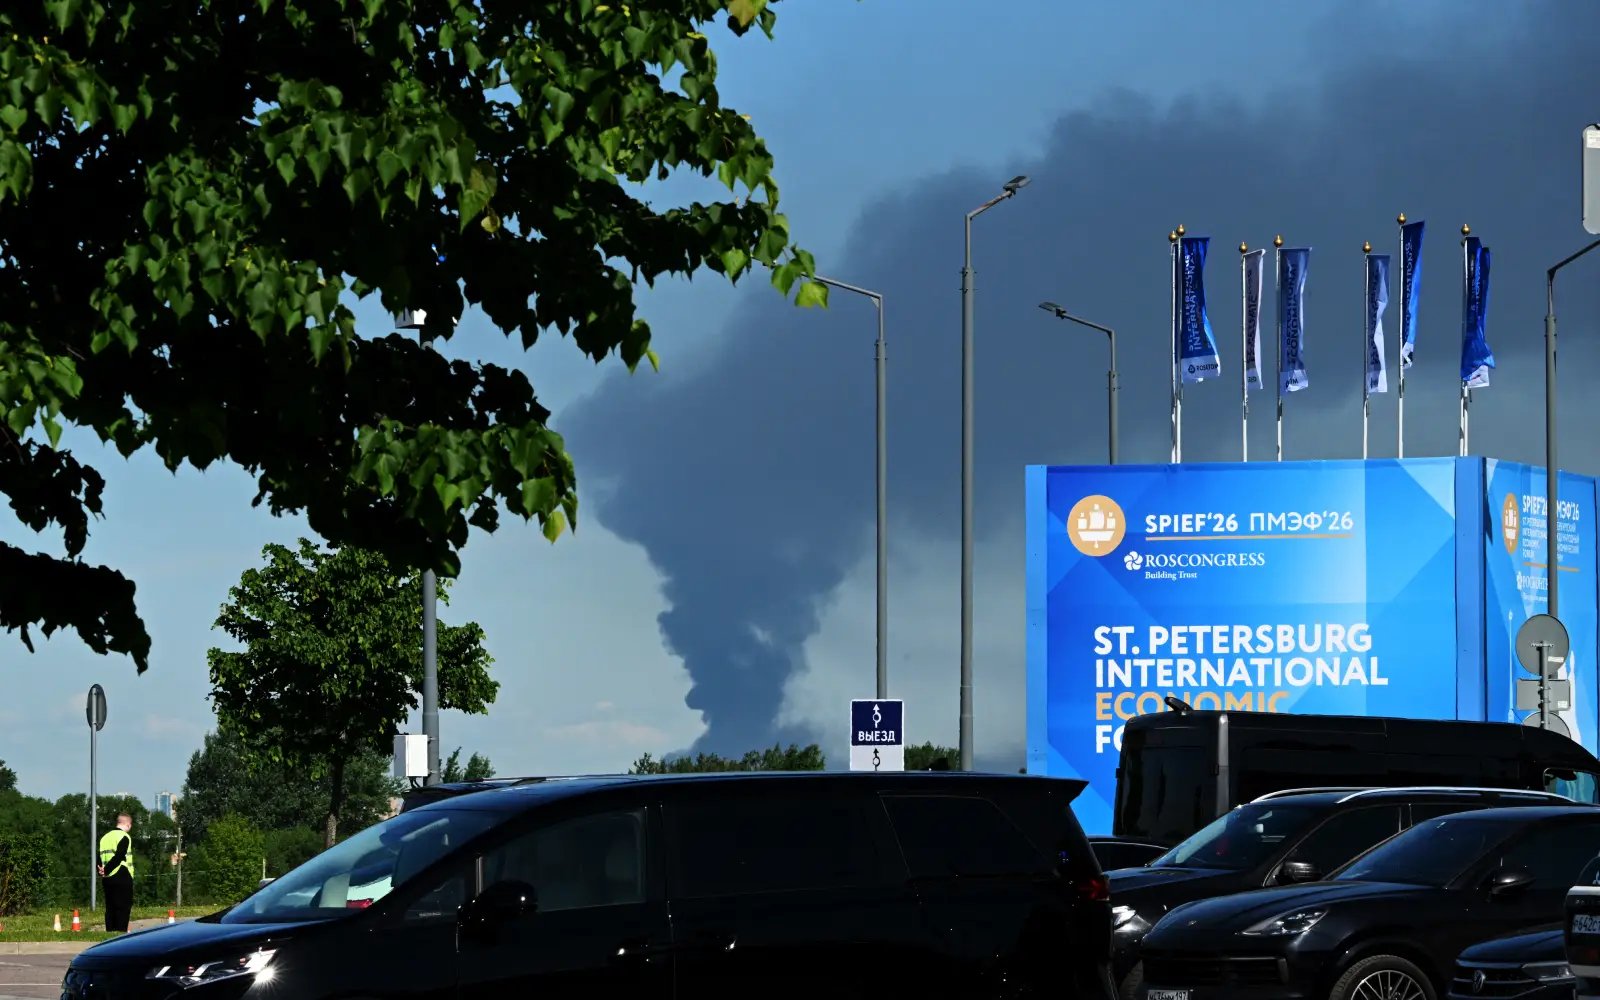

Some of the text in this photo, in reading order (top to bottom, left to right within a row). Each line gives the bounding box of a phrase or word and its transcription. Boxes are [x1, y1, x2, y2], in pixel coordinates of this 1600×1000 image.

[1556, 500, 1580, 521] МЭФ'26
[1145, 552, 1266, 568] ROSCONGRESS
[1144, 570, 1198, 581] Building Trust
[1093, 622, 1373, 656] ST. PETERSBURG
[1095, 656, 1389, 688] INTERNATIONAL
[858, 730, 895, 742] ВЫЕЗД
